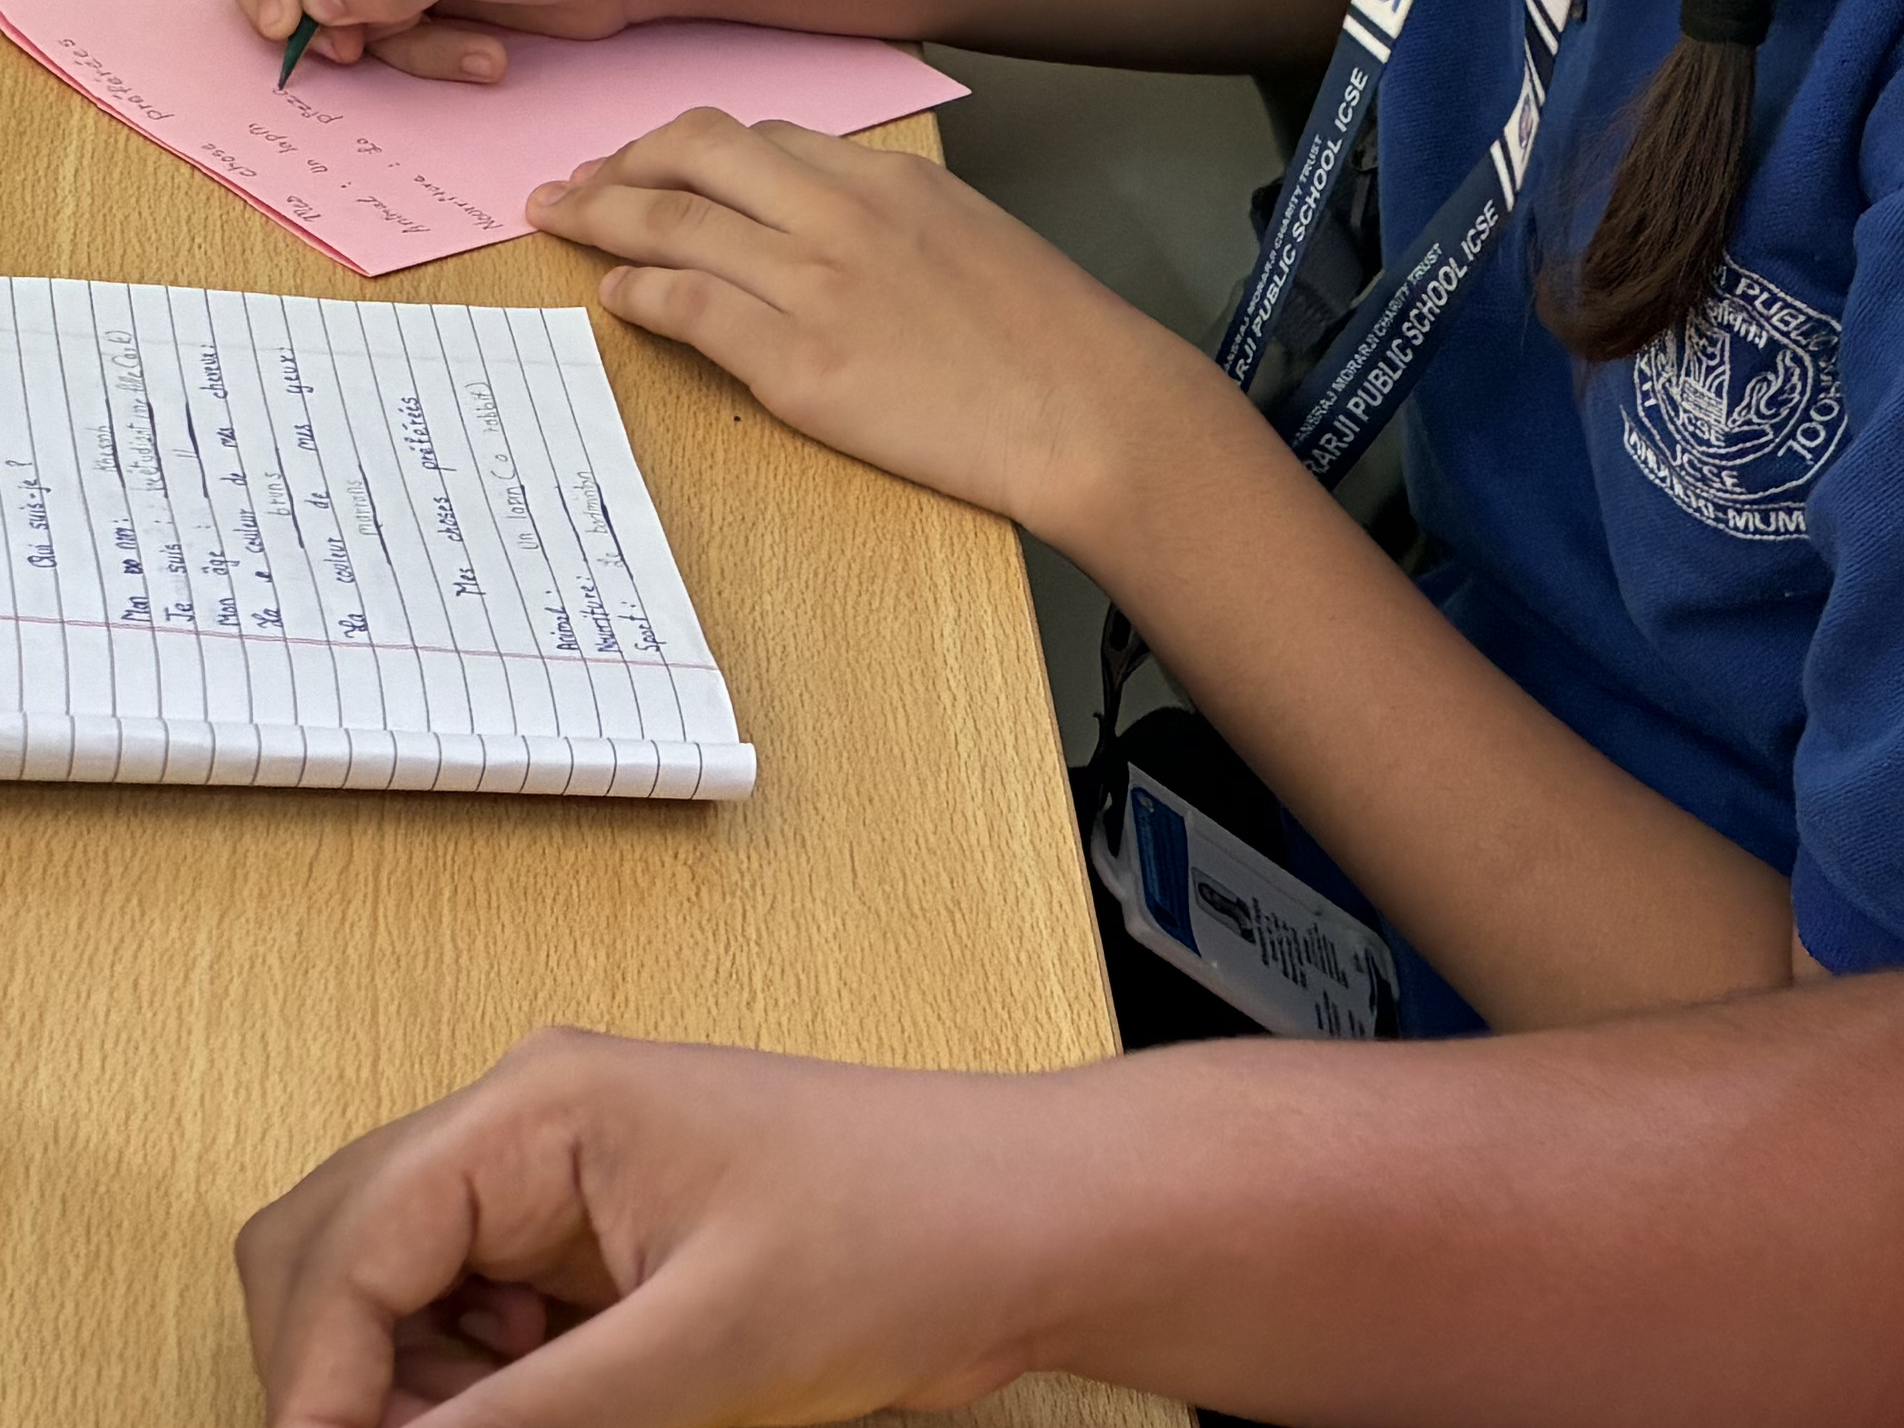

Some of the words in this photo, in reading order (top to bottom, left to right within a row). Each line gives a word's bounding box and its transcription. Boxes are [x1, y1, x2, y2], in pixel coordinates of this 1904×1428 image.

[1252, 243, 1296, 337] PUBLIC
[1292, 138, 1343, 243] SCHOOL
[1334, 67, 1369, 133] ICSE
[1407, 242, 1443, 286] TRUST
[1347, 338, 1413, 422] PUBLIC
[1401, 257, 1468, 346] SCHOOL
[1460, 198, 1499, 261] ICSE
[159, 542, 186, 574] suis
[165, 603, 195, 623] Je
